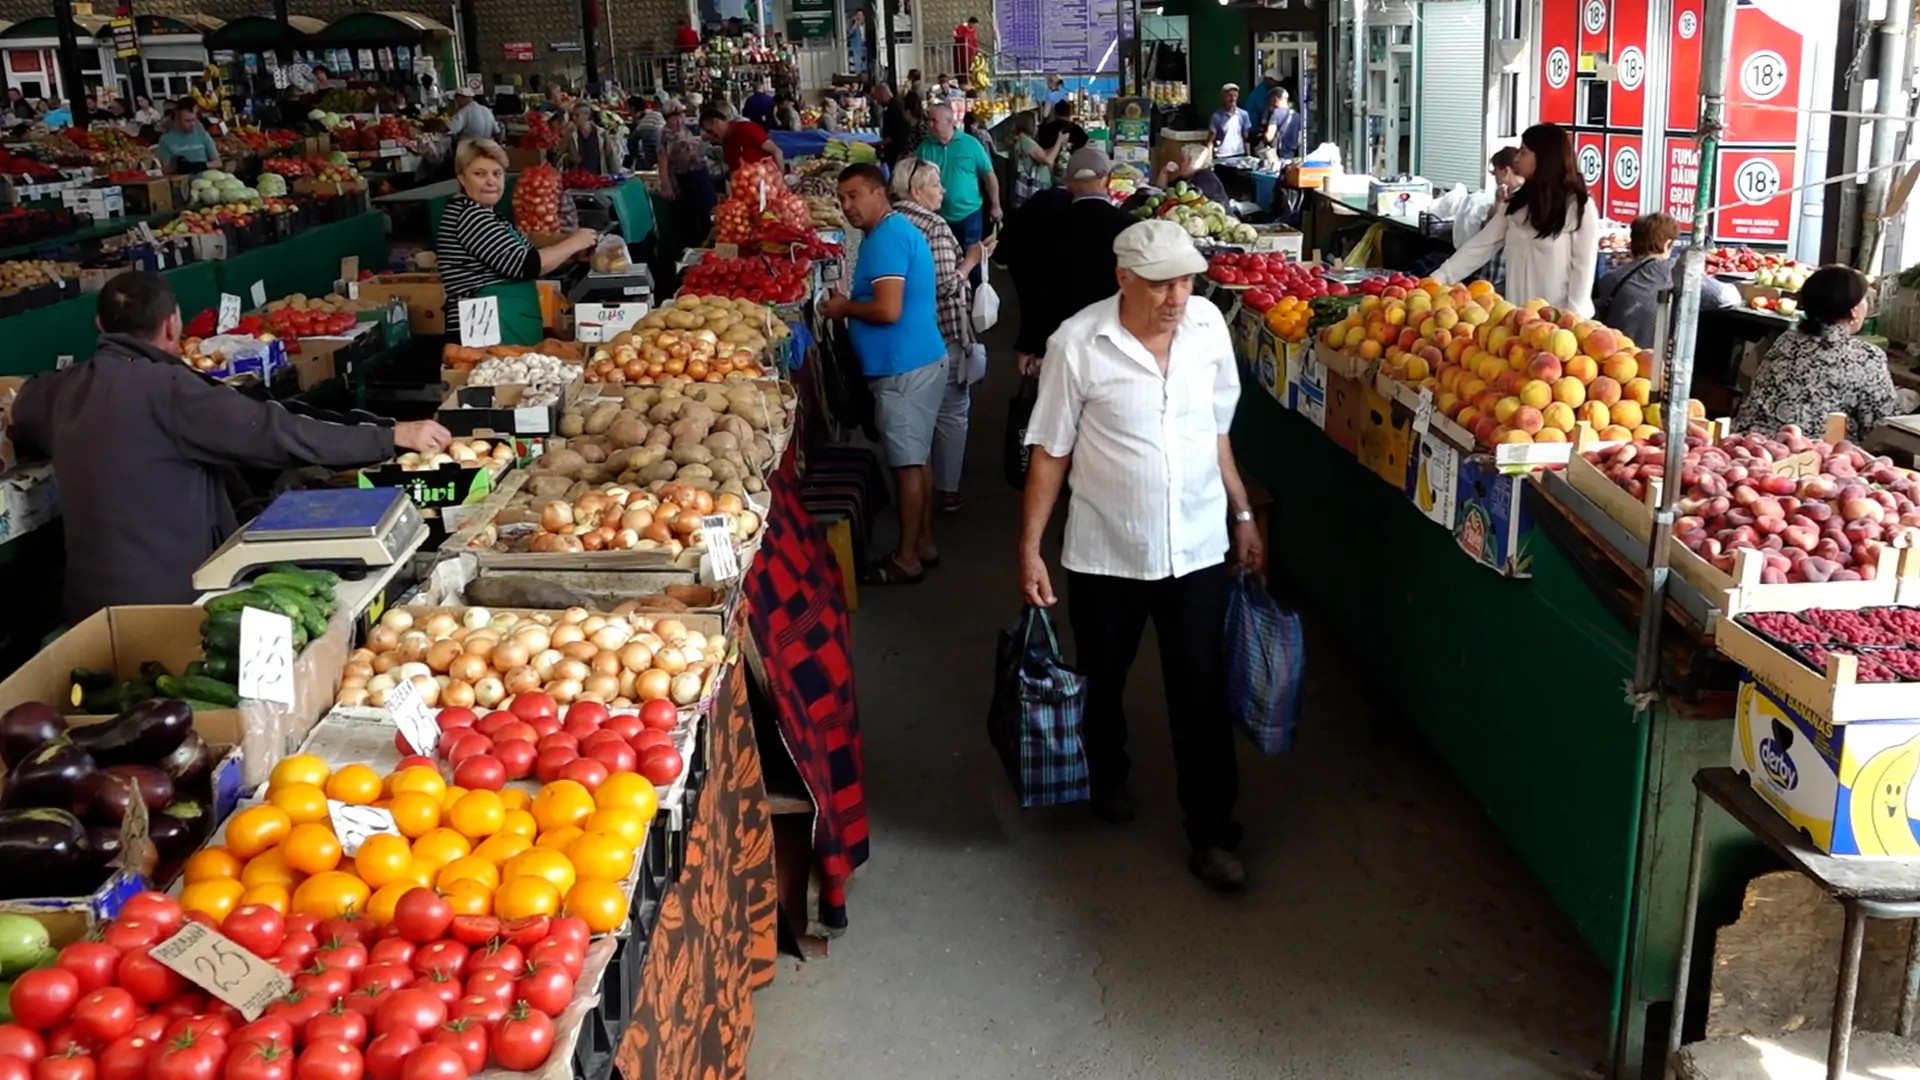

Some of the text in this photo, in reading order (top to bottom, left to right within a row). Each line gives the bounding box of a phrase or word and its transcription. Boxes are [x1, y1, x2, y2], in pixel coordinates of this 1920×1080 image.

[1589, 6, 1605, 25] 18+
[1551, 58, 1569, 78] 18+
[1624, 58, 1643, 79] 18+
[1752, 63, 1785, 87] 18+
[1583, 155, 1601, 175] 18+
[1620, 157, 1639, 178] 18+
[1671, 147, 1701, 167] FUMA
[1670, 165, 1698, 186] DĂUN
[1745, 170, 1778, 193] 18+
[395, 478, 456, 507] iwi
[1761, 736, 1797, 791] derby
[194, 939, 251, 993] 25
